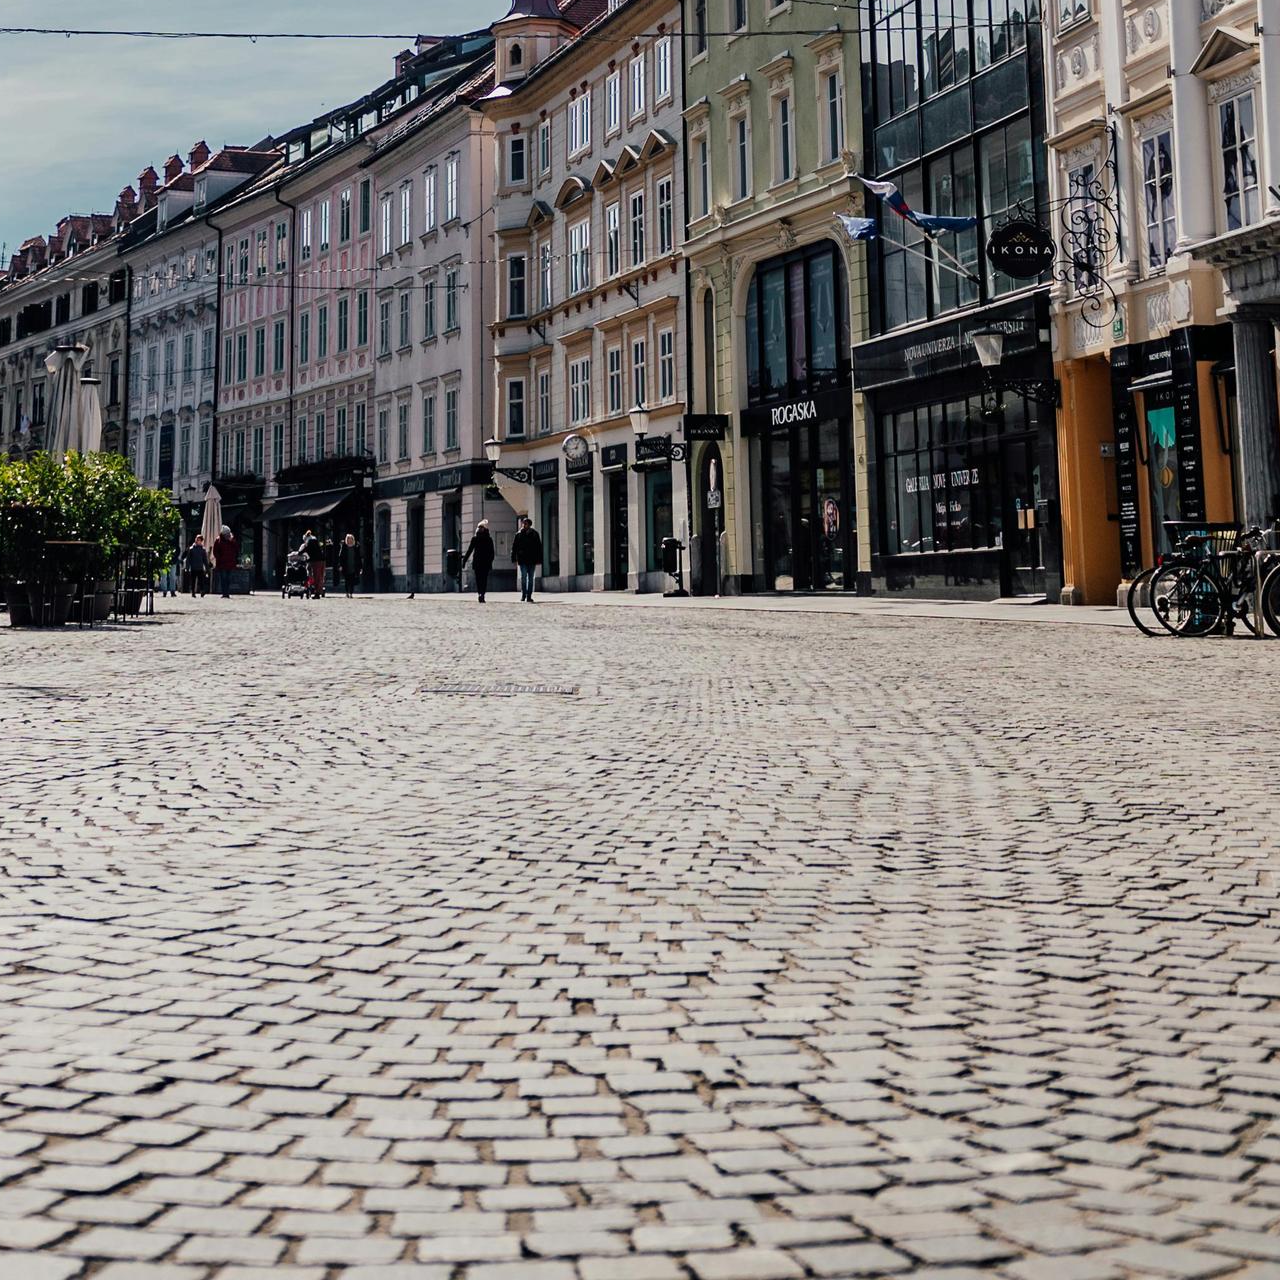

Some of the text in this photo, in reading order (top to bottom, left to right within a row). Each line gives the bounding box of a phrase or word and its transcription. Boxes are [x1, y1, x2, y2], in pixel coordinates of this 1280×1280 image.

[992, 246, 1053, 256] IKONA
[920, 336, 955, 357] UNIVERZA
[771, 400, 817, 426] ROGASKA
